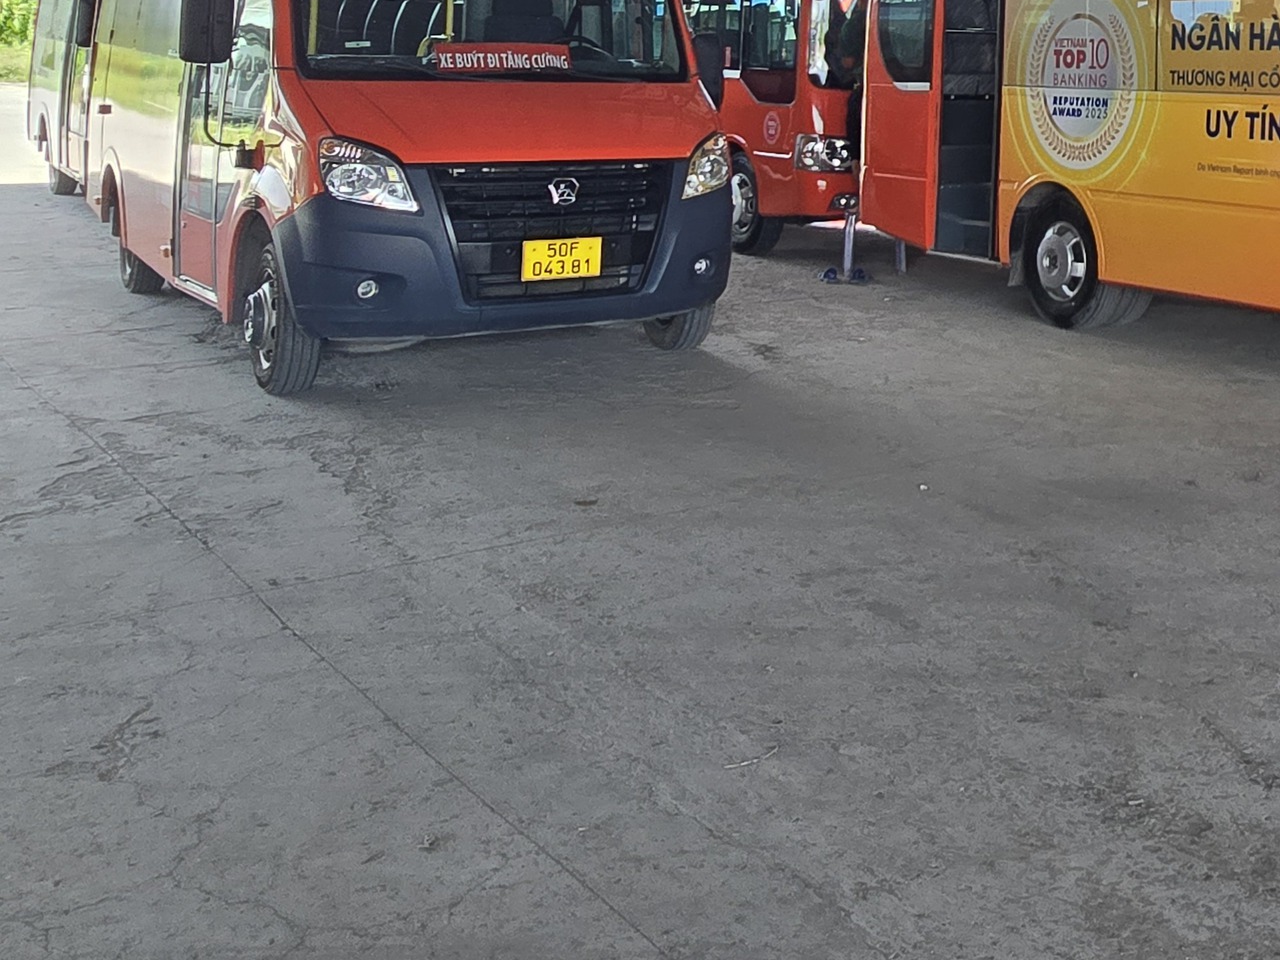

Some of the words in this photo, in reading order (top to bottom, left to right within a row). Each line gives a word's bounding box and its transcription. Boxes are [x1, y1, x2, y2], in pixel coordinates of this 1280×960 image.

[1171, 15, 1241, 51] NGÂN
[1054, 38, 1087, 48] VIETNAM
[439, 52, 453, 69] XE
[455, 51, 485, 69] BUÝT
[487, 53, 500, 69] ĐI
[502, 51, 530, 69] TĂNG
[1053, 49, 1086, 69] TOP
[1088, 38, 1109, 70] 10
[1053, 73, 1107, 89] BANKING
[1169, 69, 1225, 86] THƯƠNG
[1229, 71, 1254, 91] MẠI
[1258, 64, 1280, 88] CỔ
[1052, 96, 1109, 107] REPUTATION
[1052, 107, 1082, 117] AWARD
[1085, 108, 1108, 119] 2025
[1206, 109, 1239, 138] UY
[547, 242, 579, 258] 50F
[533, 258, 590, 277] 043.81
